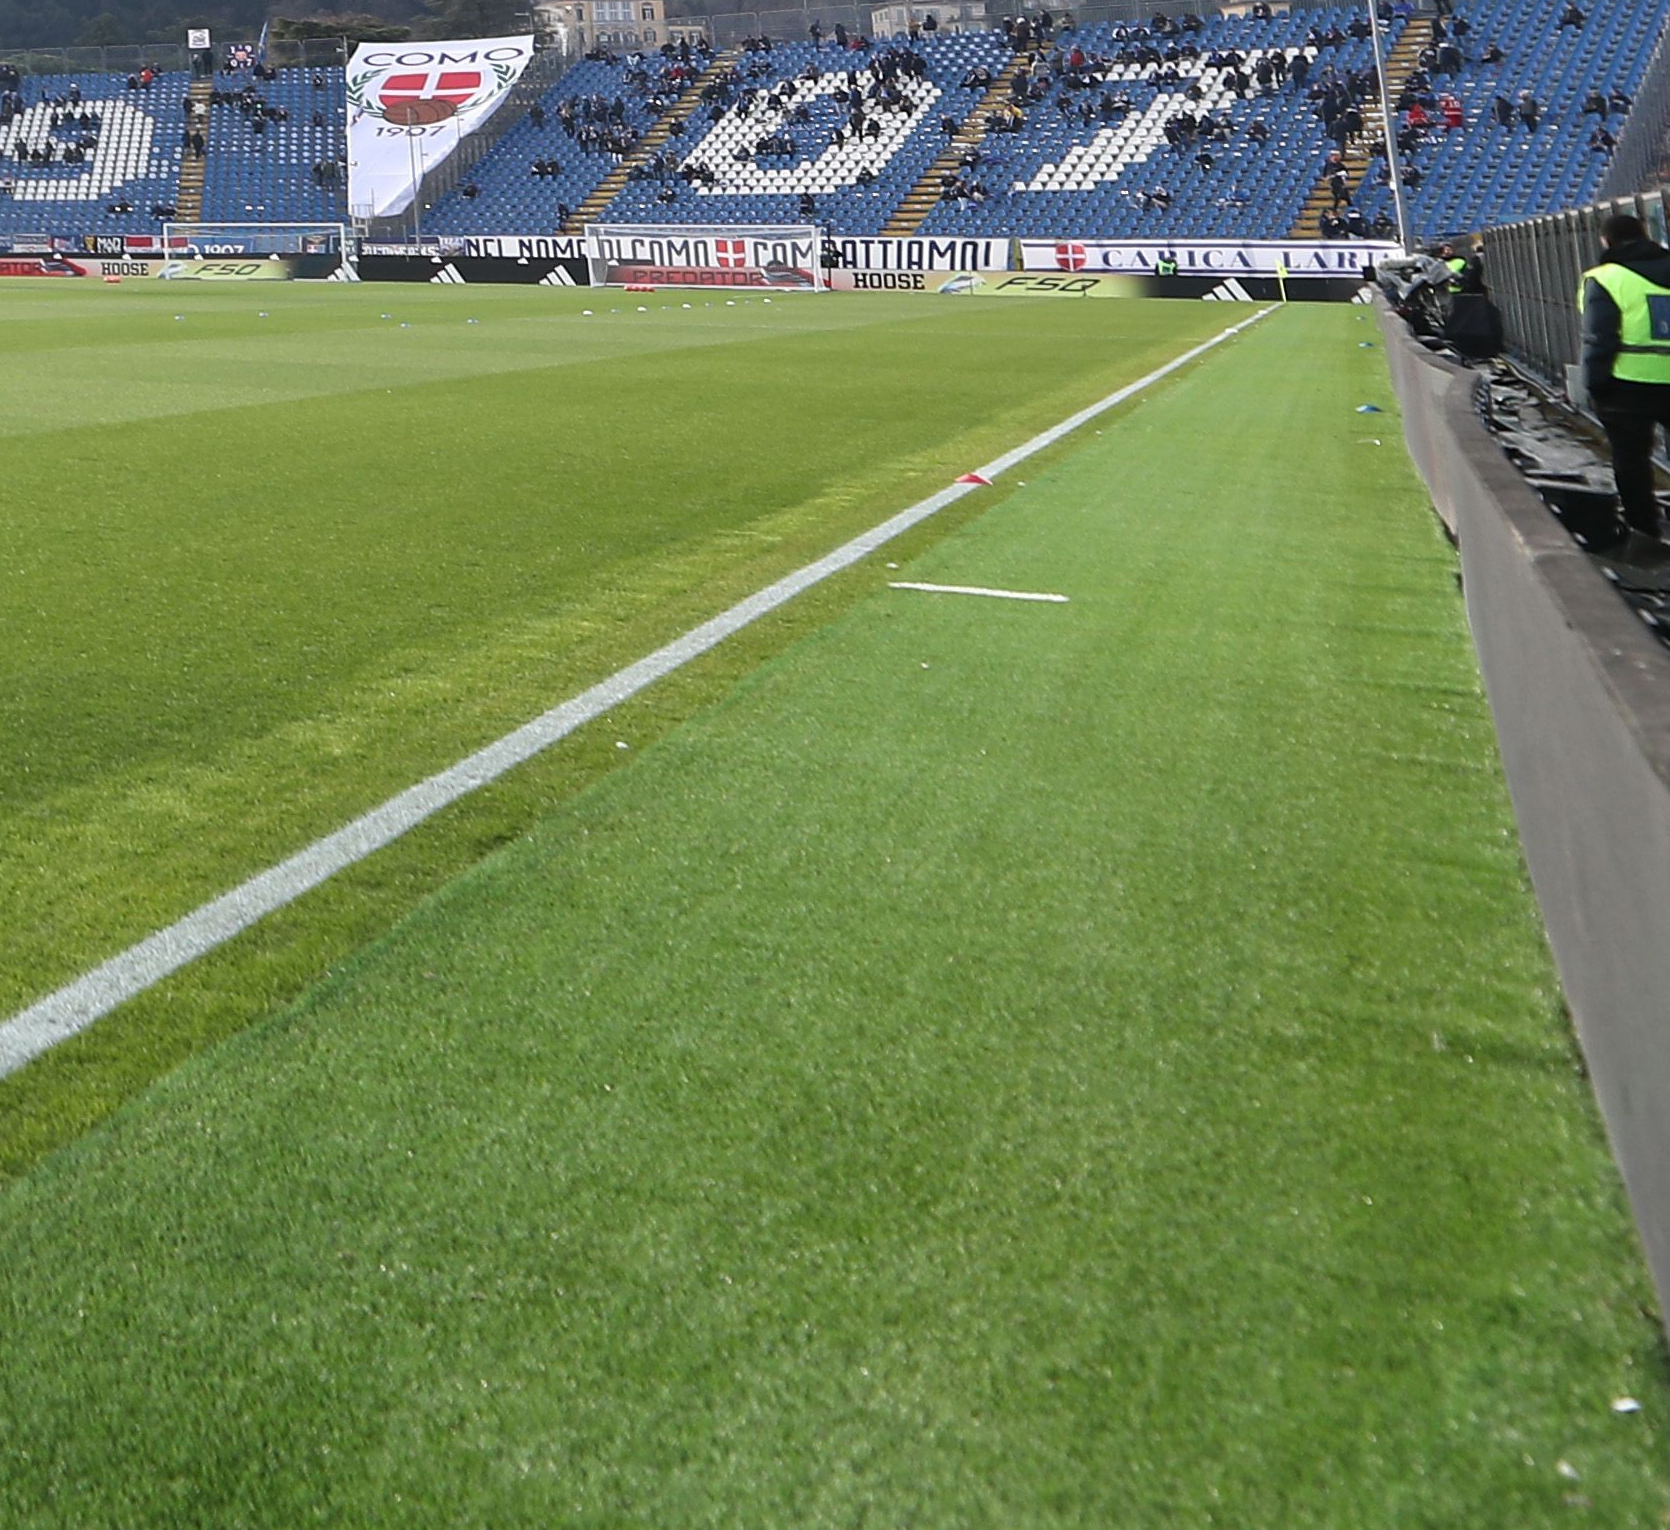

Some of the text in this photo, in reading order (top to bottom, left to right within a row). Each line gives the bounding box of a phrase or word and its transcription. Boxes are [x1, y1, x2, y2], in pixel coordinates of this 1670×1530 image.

[362, 47, 524, 67] COMO
[374, 125, 447, 138] 1907
[1102, 249, 1253, 268] CARICA
[632, 270, 765, 285] PREDATOR
[852, 272, 925, 290] HOOSE
